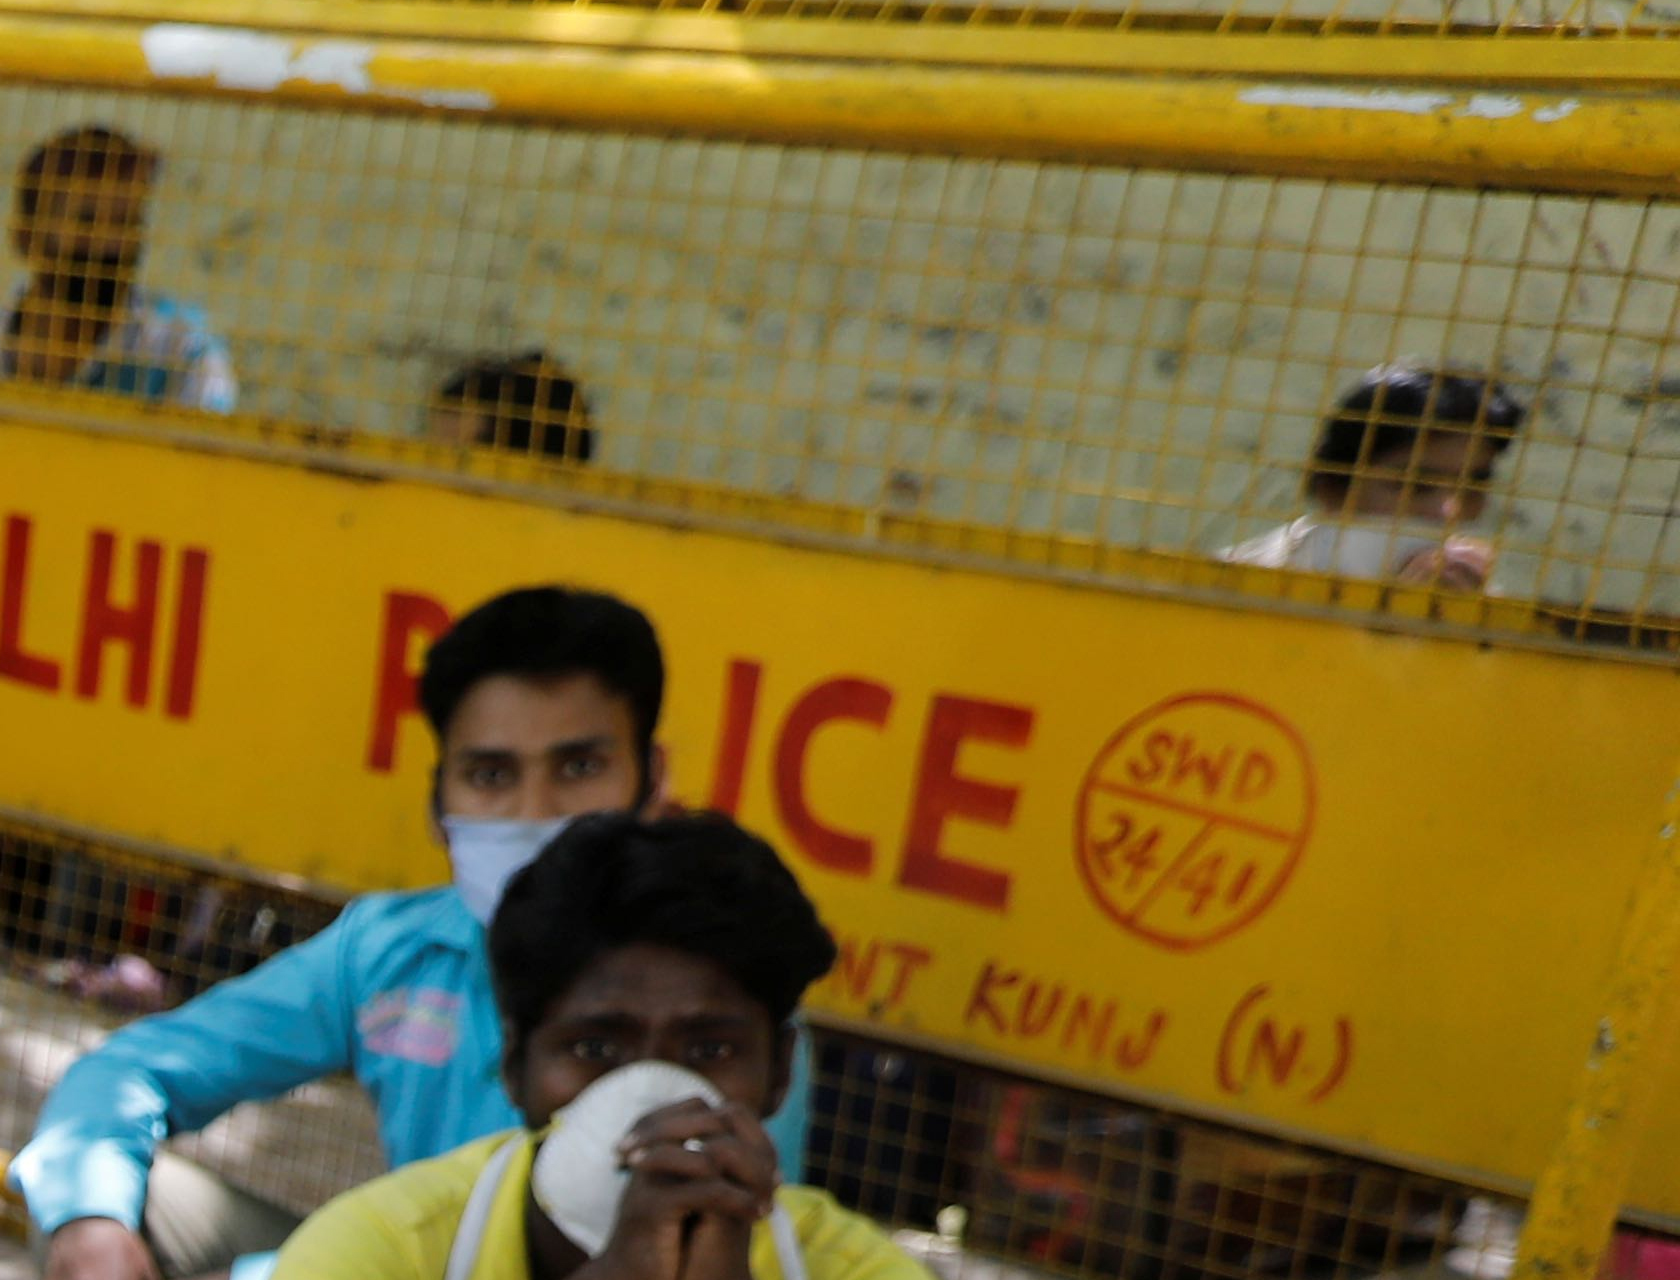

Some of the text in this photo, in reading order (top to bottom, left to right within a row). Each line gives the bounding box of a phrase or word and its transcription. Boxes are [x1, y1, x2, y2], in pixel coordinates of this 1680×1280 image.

[365, 590, 1036, 914] PICE
[1125, 729, 1279, 801] SWD
[965, 957, 1168, 1072] KUNJ
